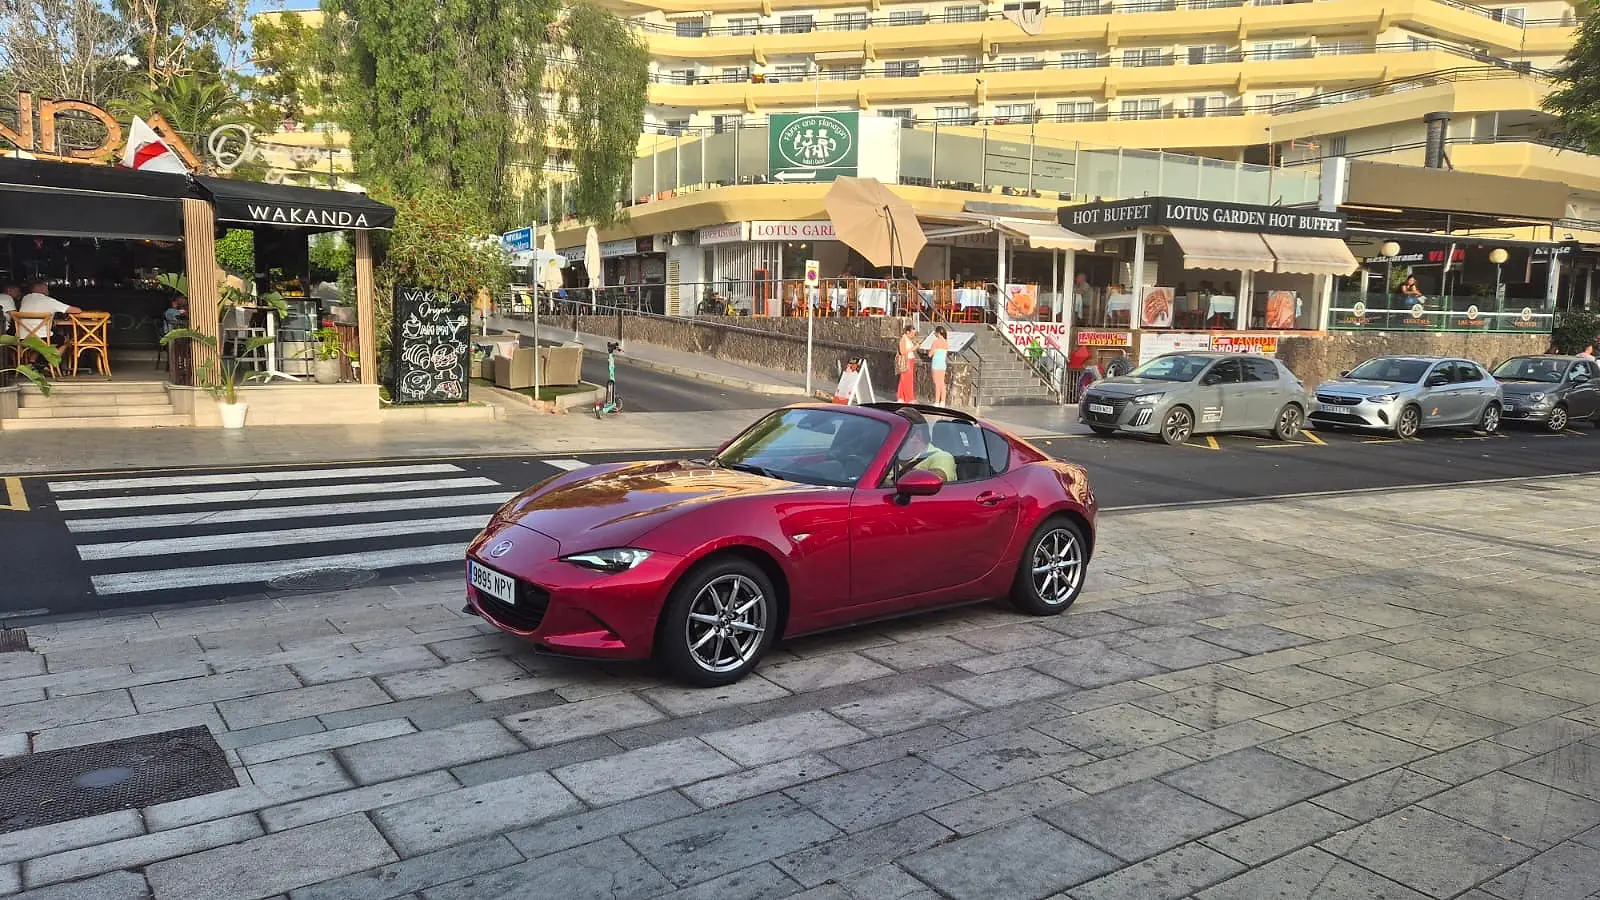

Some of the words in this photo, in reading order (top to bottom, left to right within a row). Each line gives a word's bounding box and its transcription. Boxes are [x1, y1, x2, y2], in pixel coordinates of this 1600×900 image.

[248, 205, 369, 226] WAKANDA
[1073, 209, 1100, 224] HOT
[1103, 204, 1151, 222] BUFFET
[1166, 204, 1209, 222] LOTUS
[1212, 208, 1266, 226] GARDEN
[1268, 213, 1297, 229] HOT
[1299, 216, 1342, 232] BUFFET
[758, 225, 798, 236] LOTUS
[1008, 323, 1065, 335] SHOPPING
[1211, 344, 1263, 353] SHOPPING
[473, 566, 492, 590] 9895
[494, 576, 512, 601] NPY
